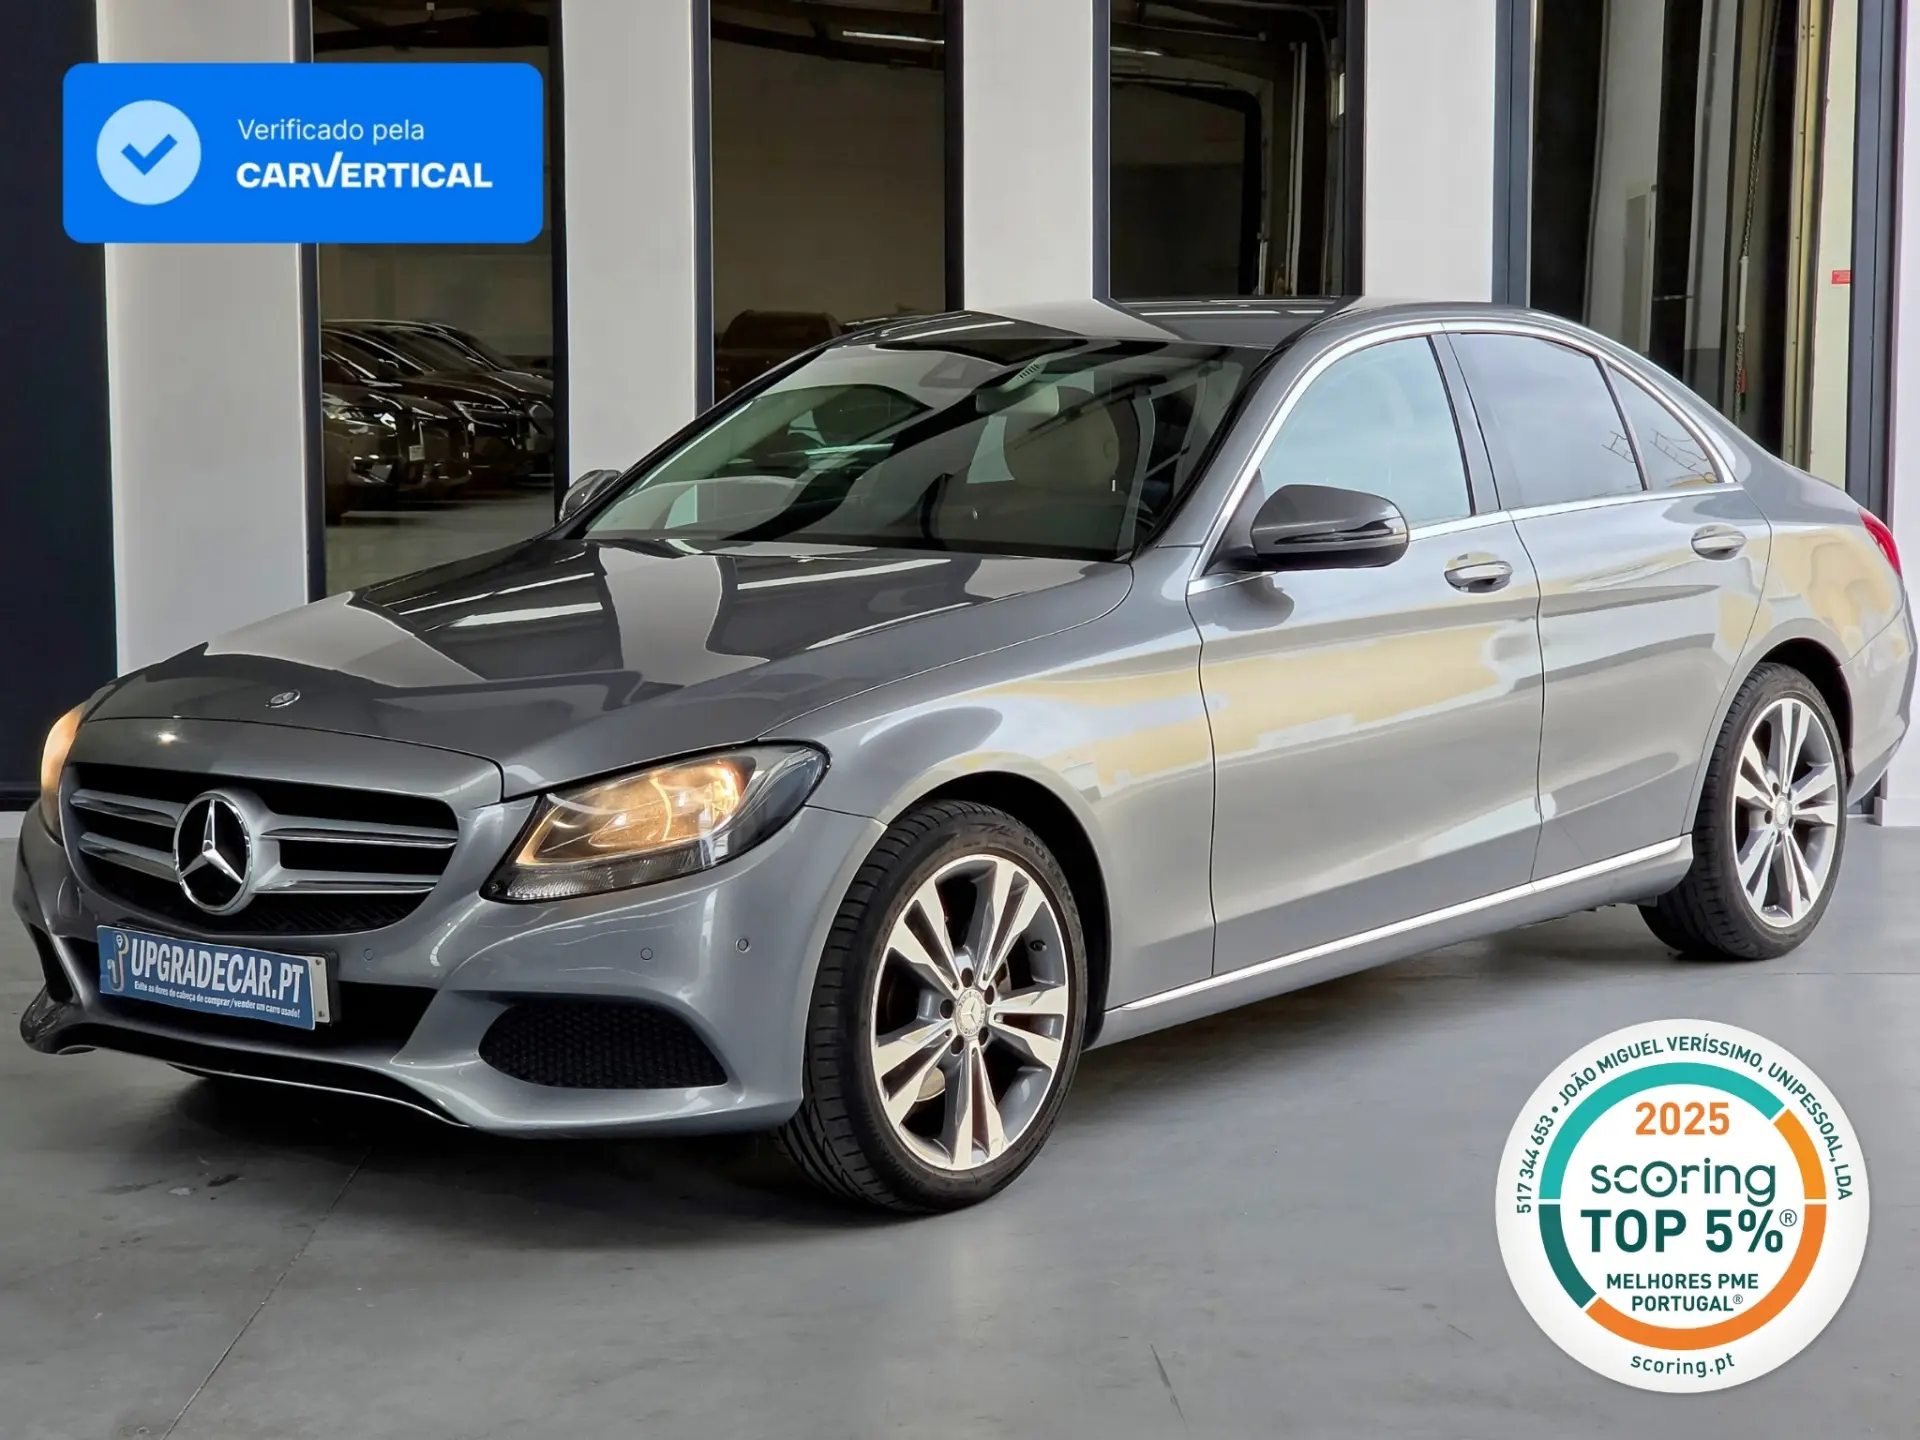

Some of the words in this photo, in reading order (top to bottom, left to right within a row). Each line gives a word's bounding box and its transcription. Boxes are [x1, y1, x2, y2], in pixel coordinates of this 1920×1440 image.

[130, 938, 304, 1004] UPGRADECAR.PT
[154, 984, 169, 997] dores
[256, 1003, 265, 1012] um
[265, 1004, 281, 1014] carro
[280, 1007, 301, 1019] usado!
